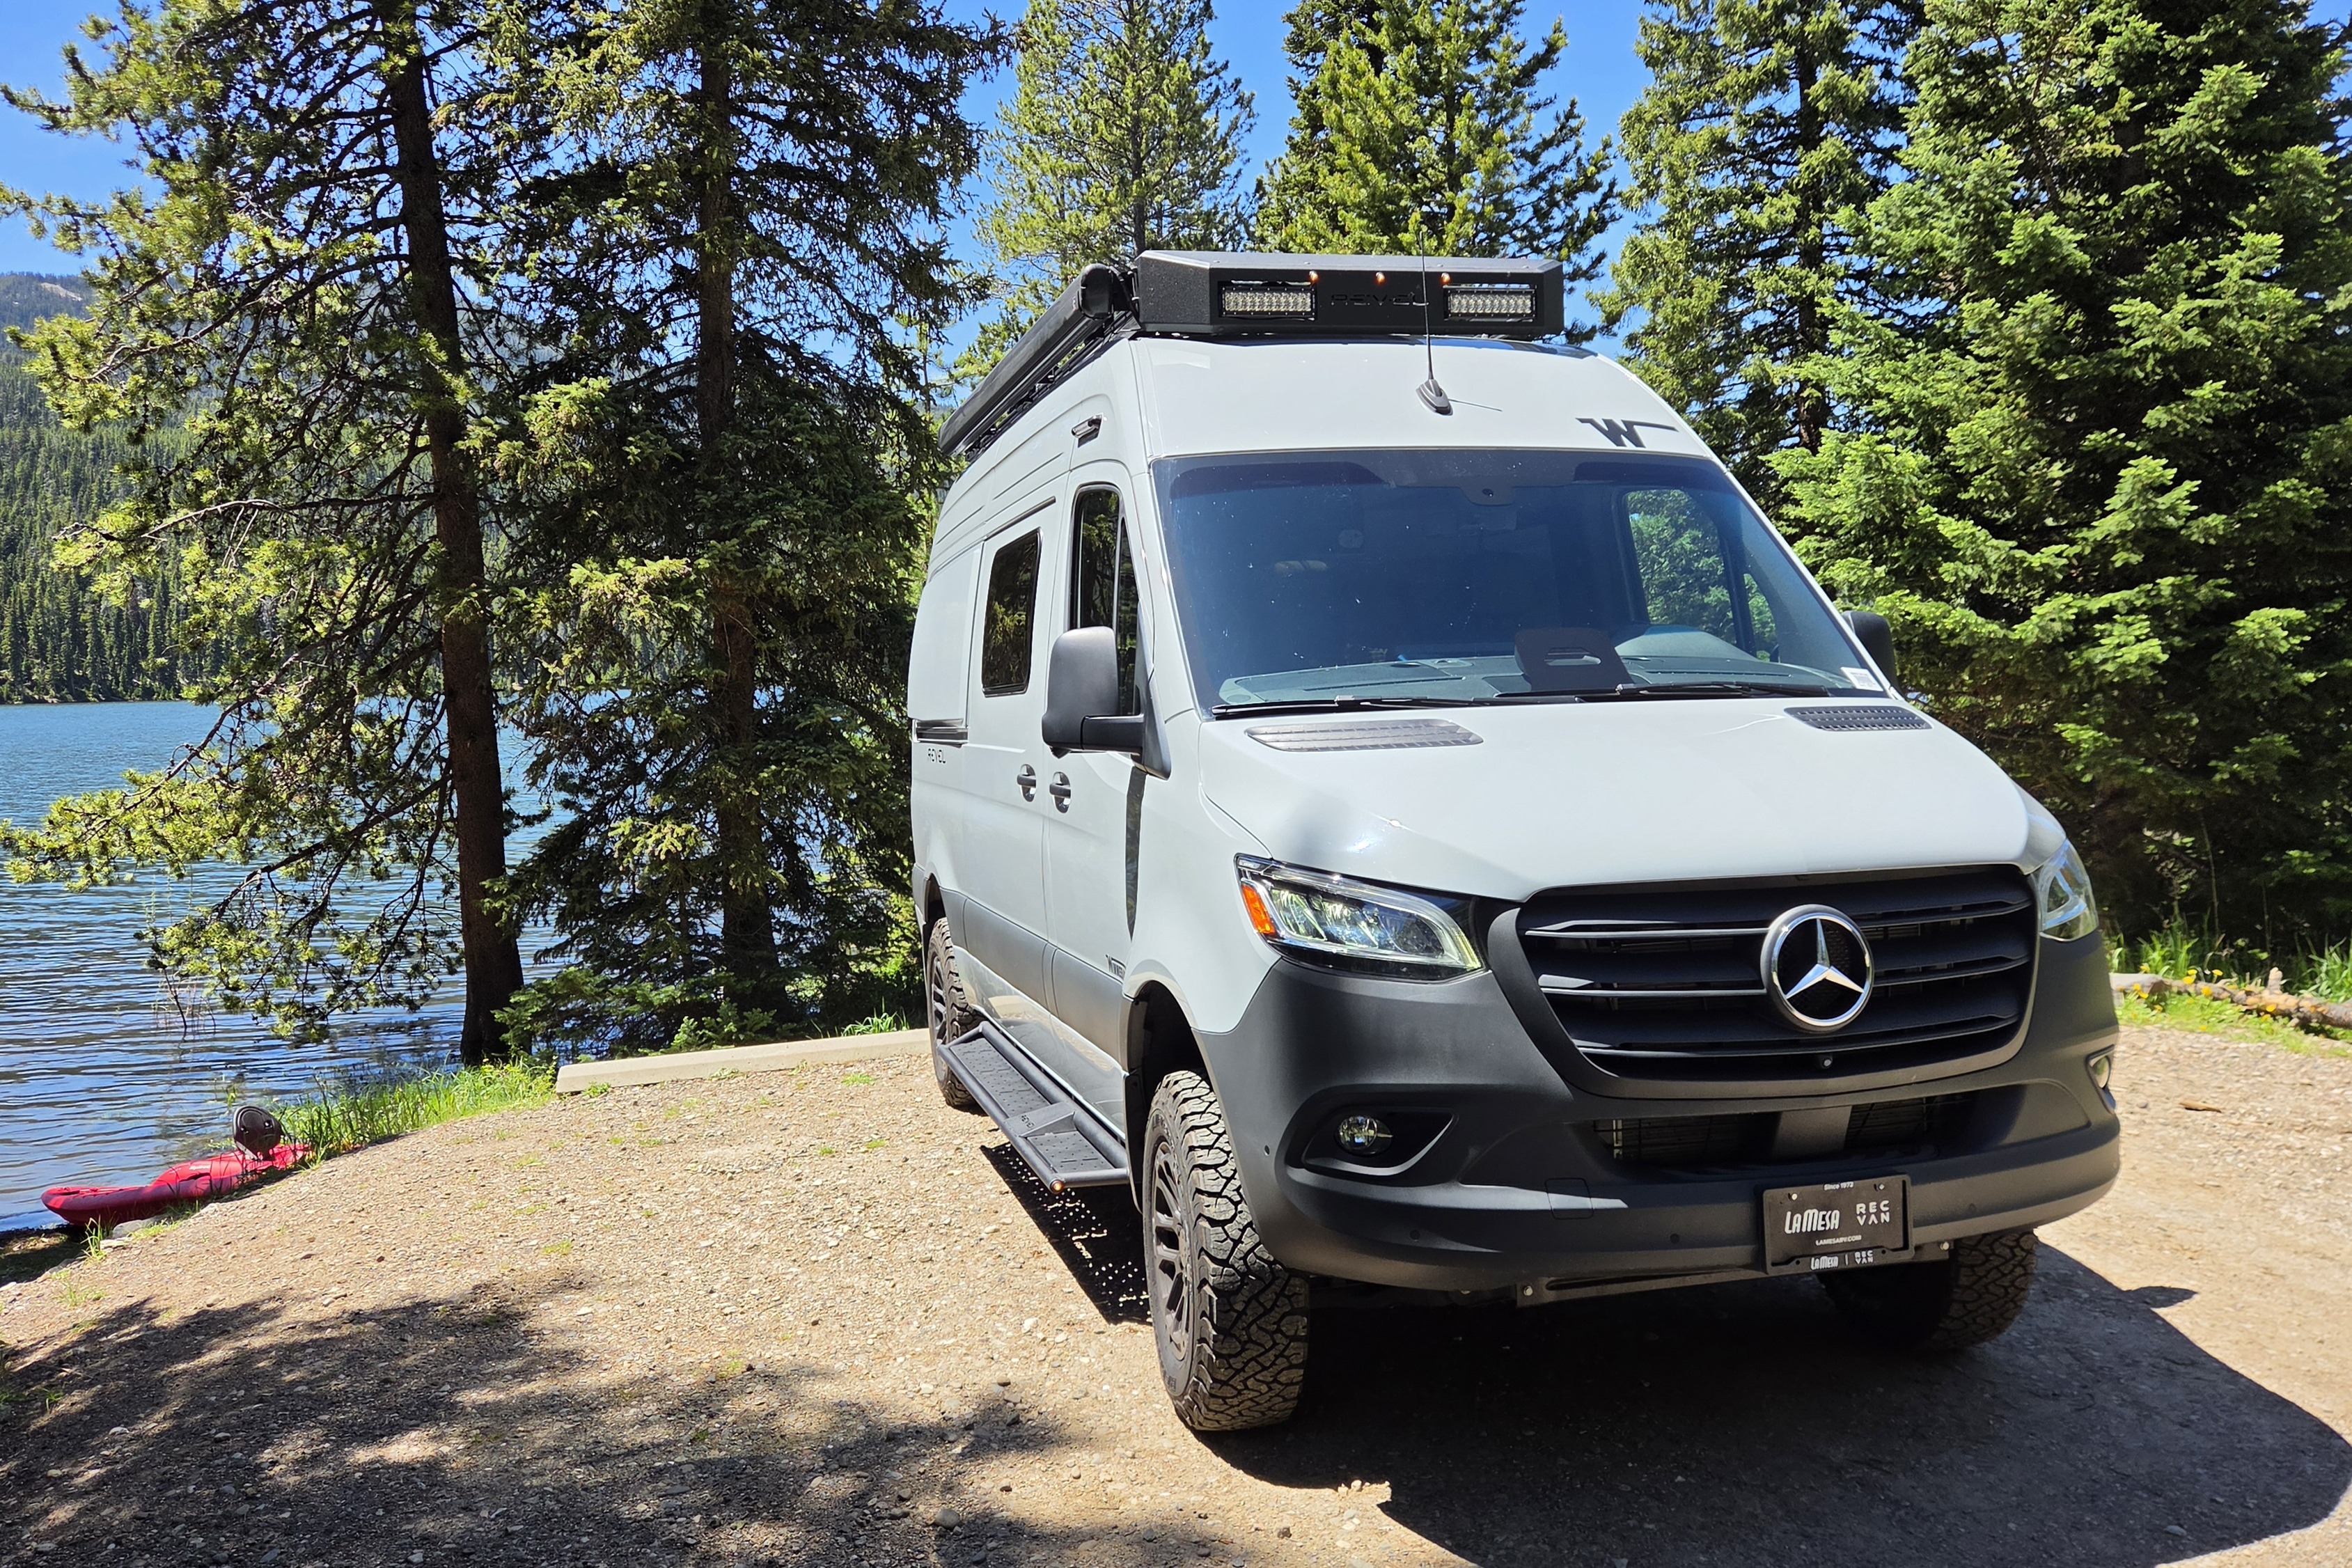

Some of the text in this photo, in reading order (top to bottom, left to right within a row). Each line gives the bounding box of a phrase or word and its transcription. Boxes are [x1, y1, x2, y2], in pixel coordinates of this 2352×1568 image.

[1856, 1200, 1890, 1215] REC
[1856, 1212, 1890, 1226] VAN
[1854, 1250, 1873, 1258] REC
[1855, 1256, 1874, 1264] VAN
